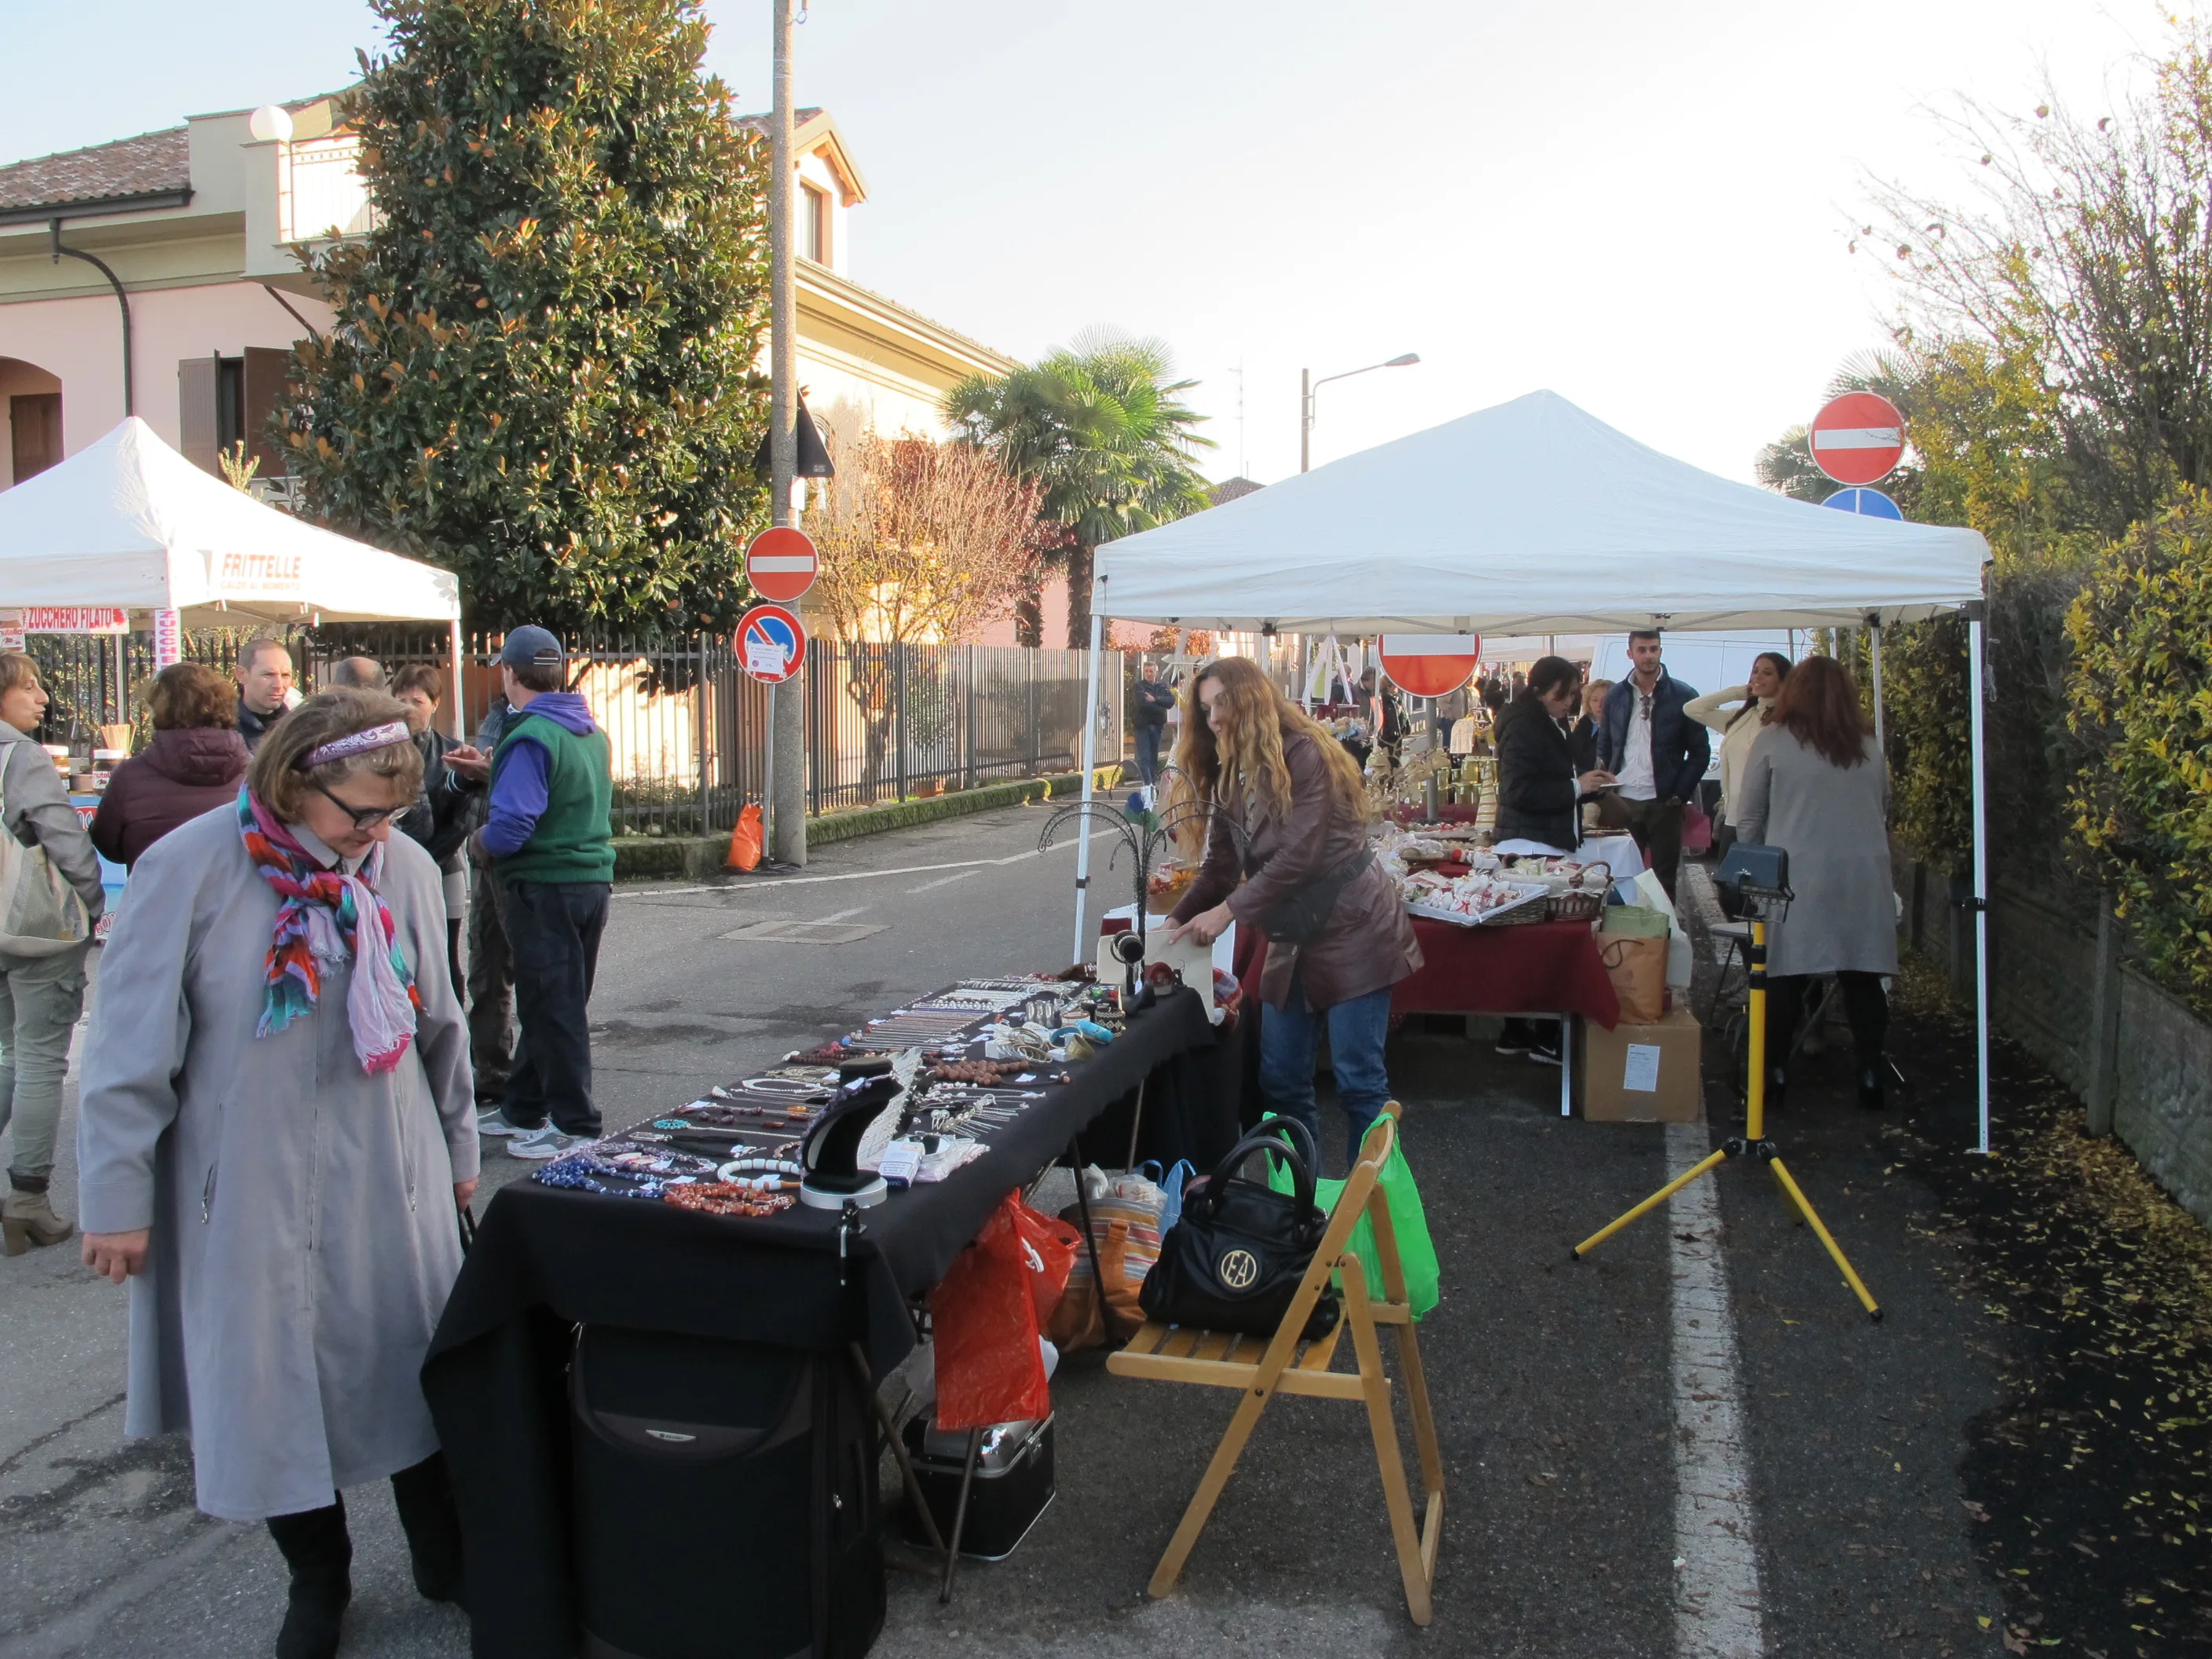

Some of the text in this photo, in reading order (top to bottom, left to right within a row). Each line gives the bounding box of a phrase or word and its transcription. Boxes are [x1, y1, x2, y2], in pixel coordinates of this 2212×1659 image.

[222, 552, 302, 579] FRITTELLE
[29, 607, 79, 629] ZUCCHERO
[81, 607, 112, 628] FILATO
[159, 610, 177, 669] ZUCCHE
